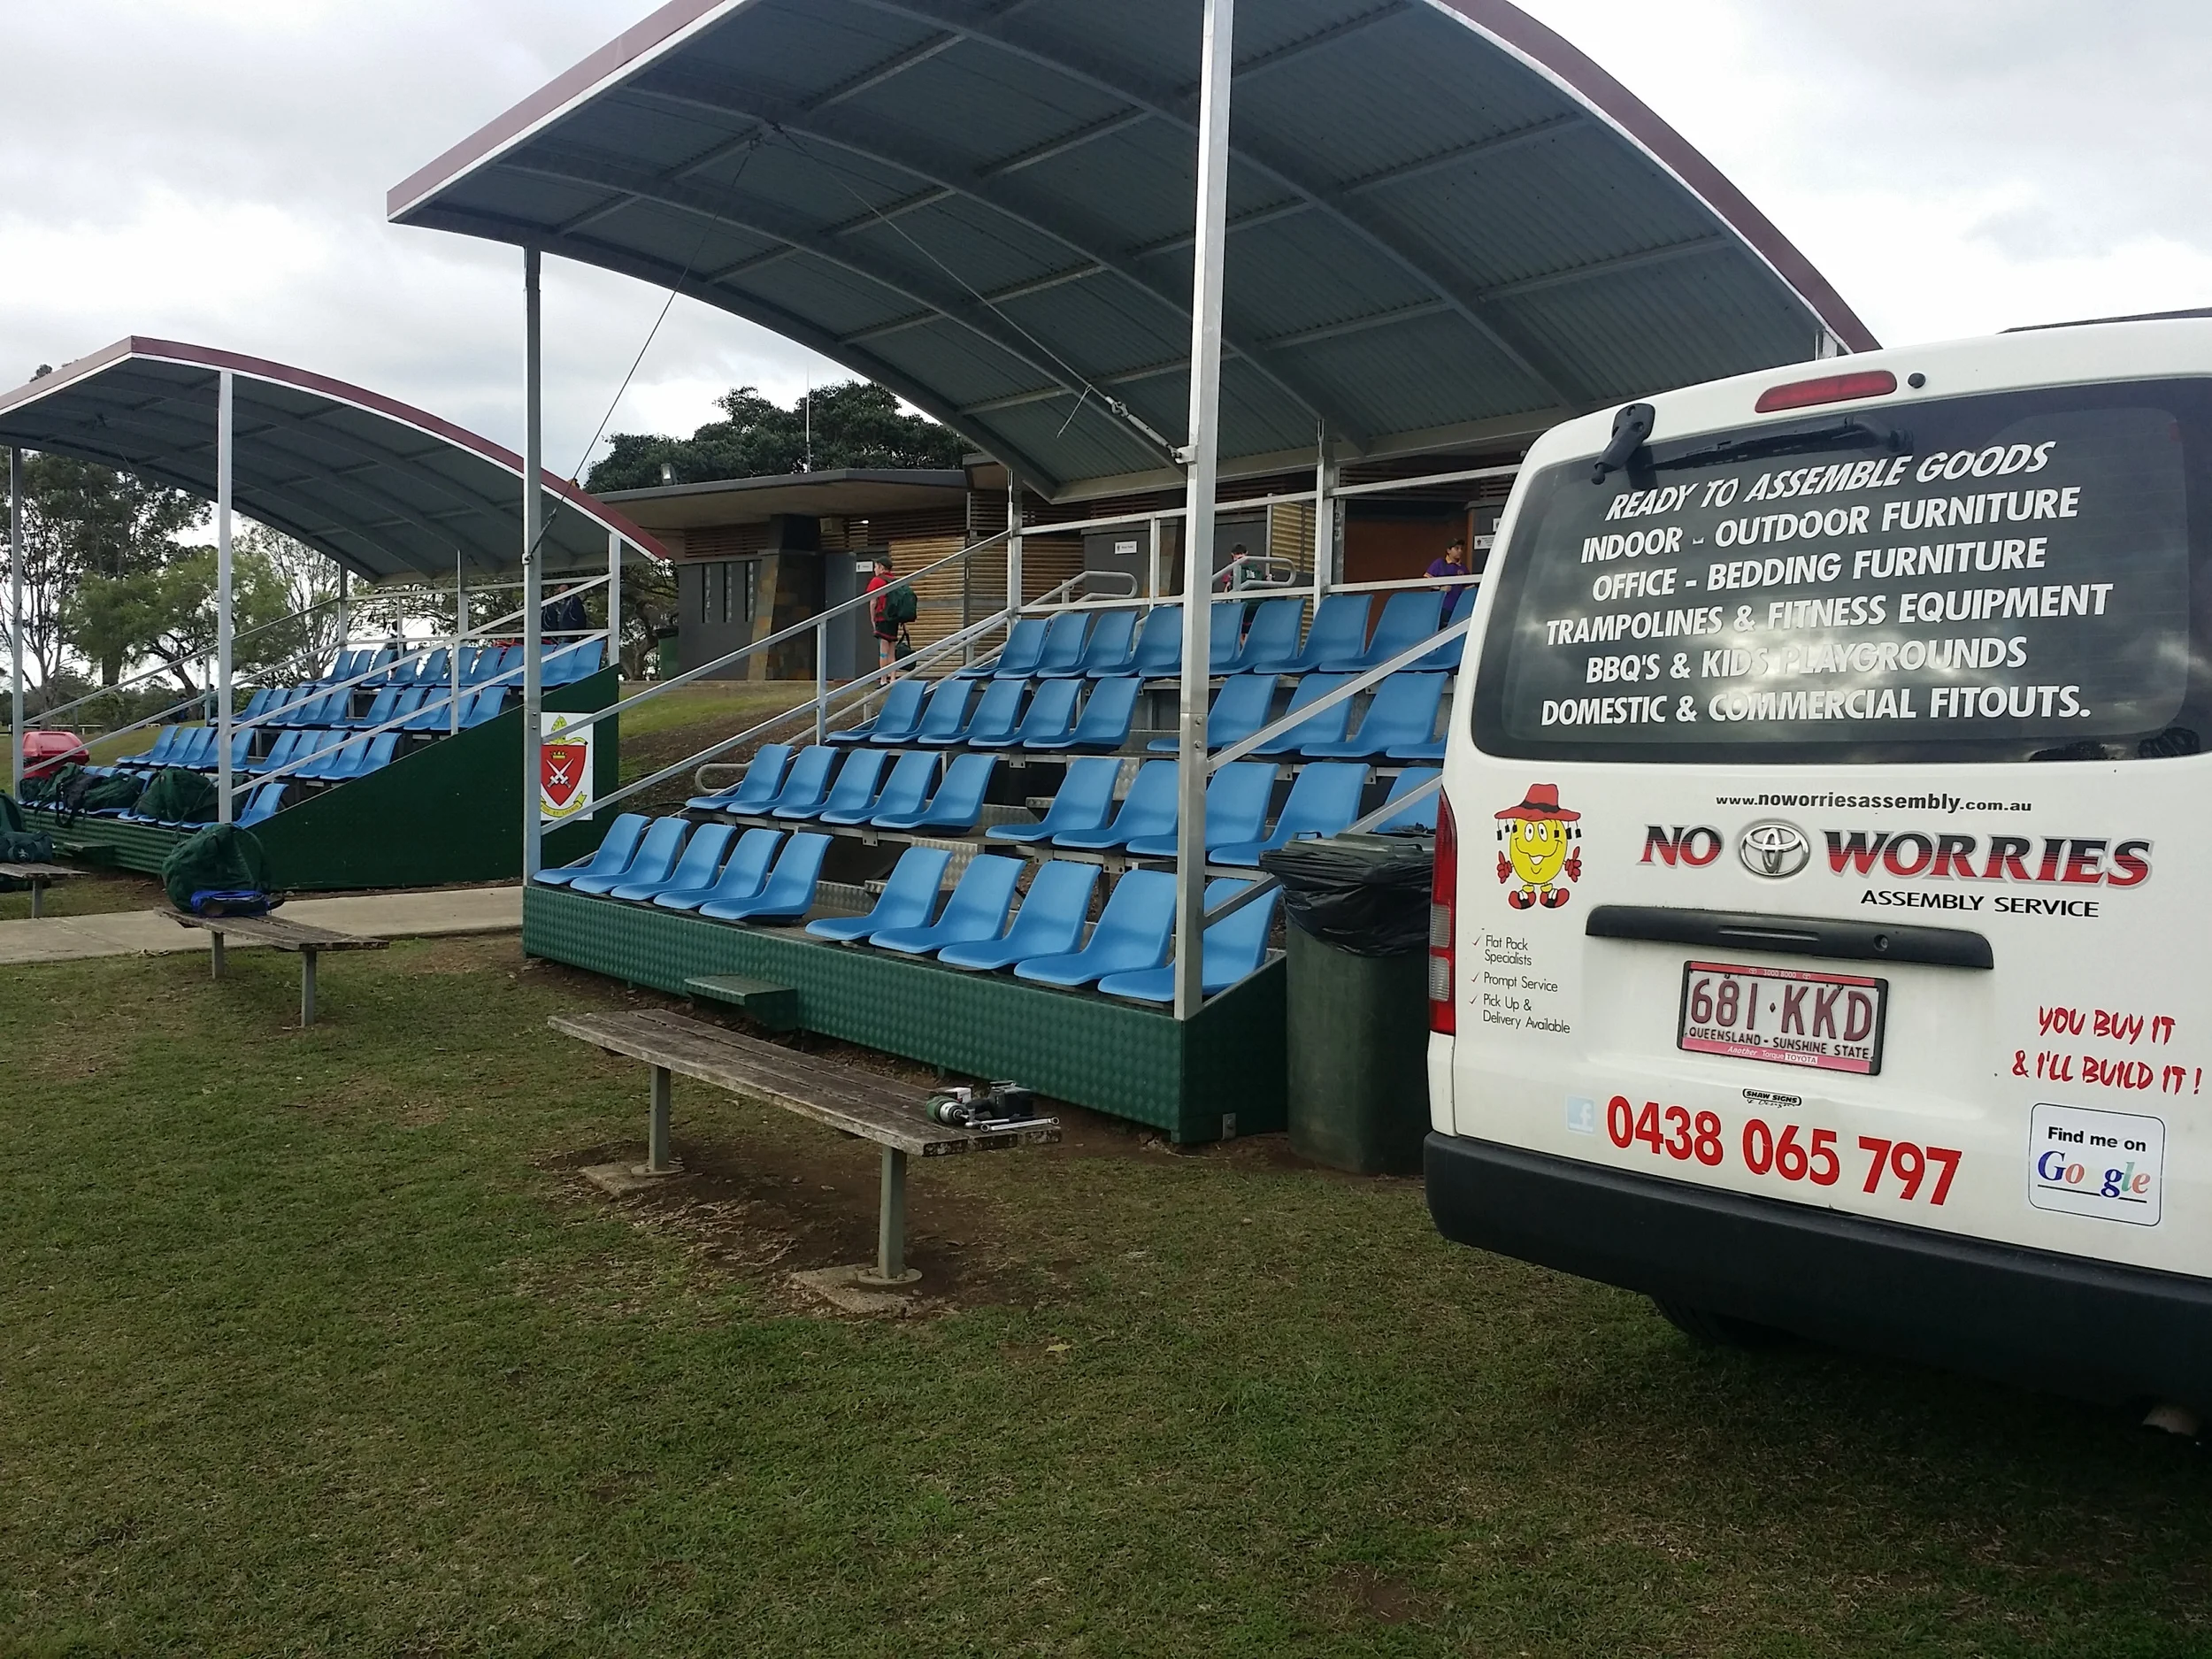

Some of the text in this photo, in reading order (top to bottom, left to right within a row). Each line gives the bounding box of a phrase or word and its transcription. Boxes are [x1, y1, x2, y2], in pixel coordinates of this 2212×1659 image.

[1605, 441, 2056, 520] READY TO ASSEMBLE GOODS
[1580, 527, 1683, 563] INDOOR
[1715, 505, 1870, 547] OUTDOOR
[1881, 487, 2081, 531] FURNITURE
[1593, 567, 1678, 601] OFFICE
[1707, 553, 1841, 591] BEDDING
[1853, 537, 2047, 580] FURNITURE
[1547, 583, 2114, 645] TRAMPOLINES & FITNESS EQUIPMENT
[1586, 636, 2027, 683] BBQ'S & KIDS PLAYGROUNDS
[1541, 685, 2091, 726] DOMESTIC & COMMERCIAL FITOUTS.
[1716, 792, 2032, 813] www.noworriesassembly.com.au
[1640, 825, 2152, 887] NO WORRIES
[1860, 890, 2100, 918] ASSEMBLY SERVICE
[1485, 949, 1532, 966] Specialists
[1486, 934, 1528, 951] Flat Pack
[1484, 972, 1558, 992] Prompt Service
[1483, 993, 1532, 1012] Pick Up &
[1483, 1010, 1571, 1033] Delivery Available
[2039, 1005, 2176, 1045] YOU BUY IT
[1689, 1026, 1761, 1046] QUEENSLAND
[1772, 1037, 1827, 1055] SUNSHINE
[1834, 1044, 1870, 1060] STATE
[1727, 1046, 1817, 1064] Another Torque TOYOTA
[2012, 1049, 2030, 1078] &
[2037, 1050, 2073, 1082] I'LL
[2082, 1056, 2154, 1090] BUILD
[1746, 1090, 1797, 1104] SHAW SIGNS
[1607, 1095, 1962, 1206] 0438 065 797
[2047, 1125, 2147, 1152] Find me on
[2037, 1150, 2151, 1198] Gogle
